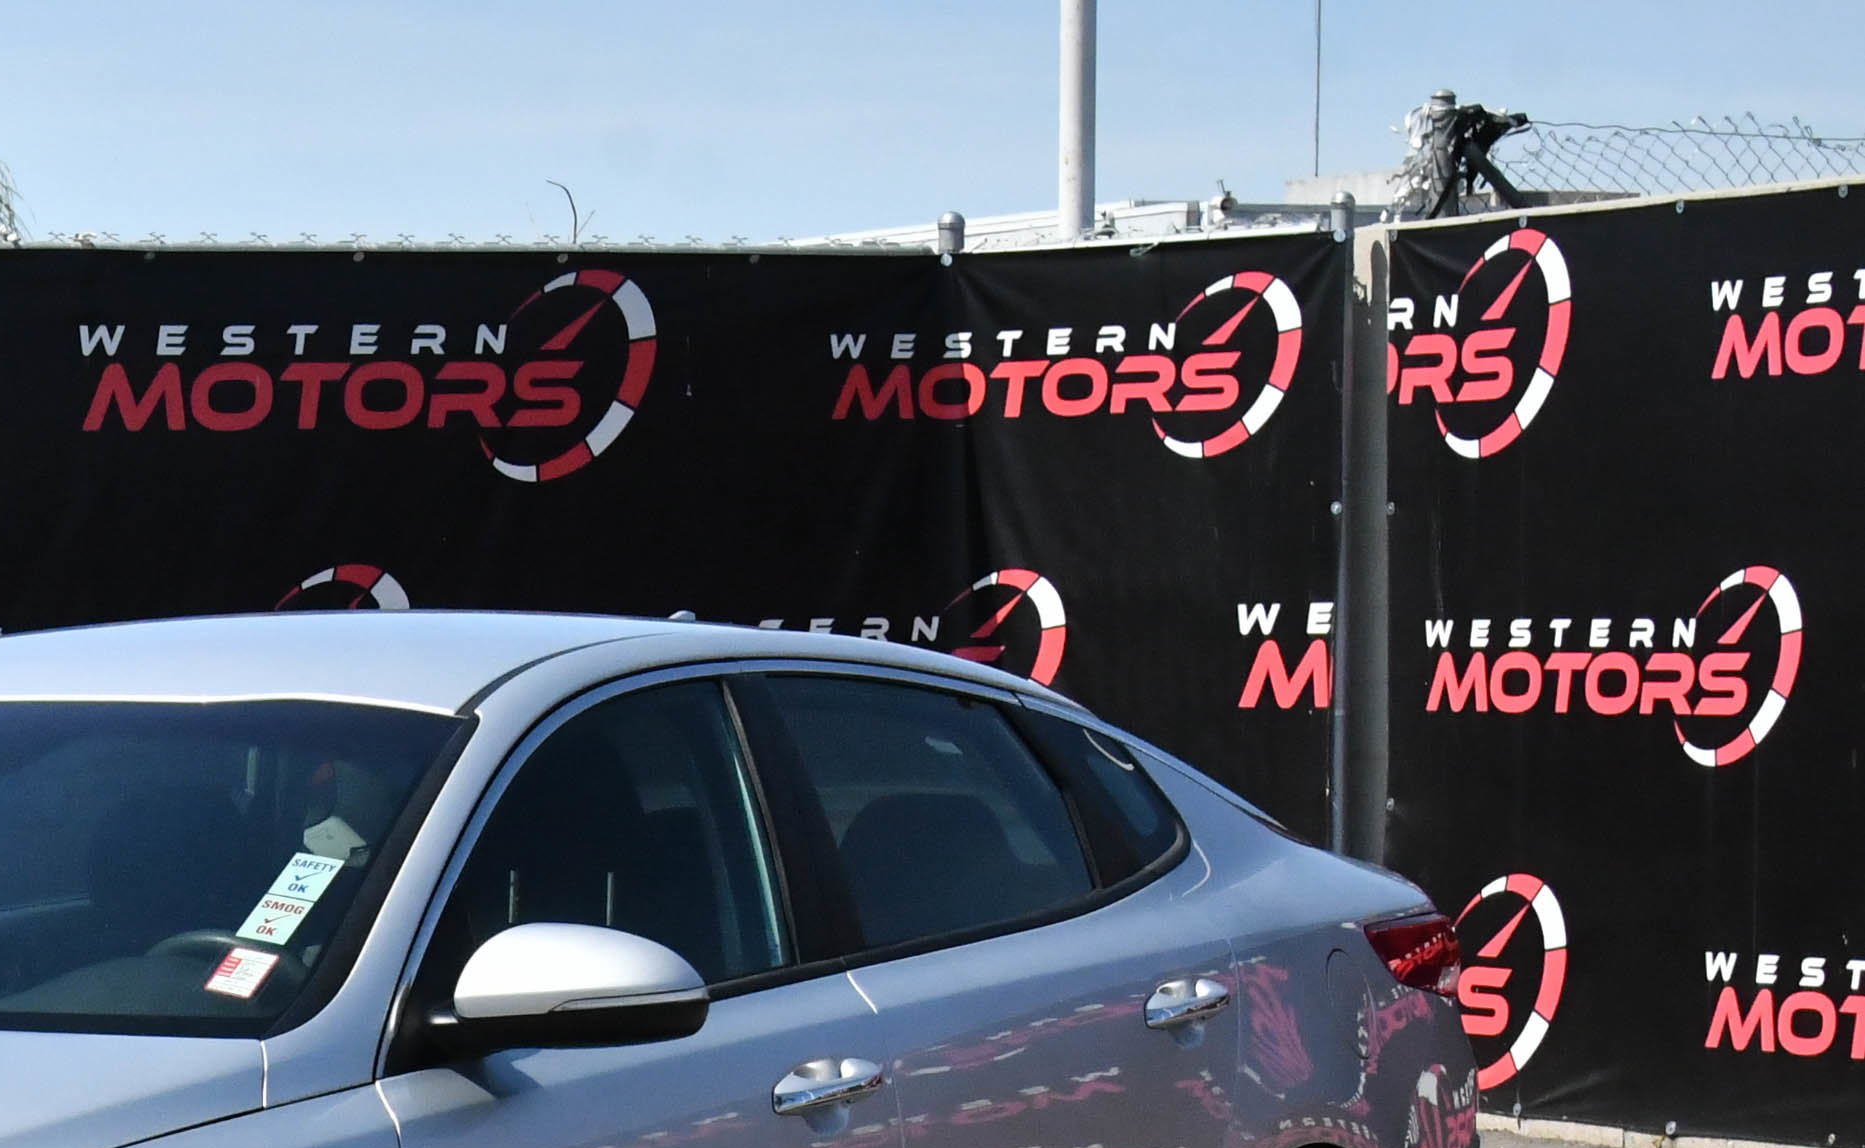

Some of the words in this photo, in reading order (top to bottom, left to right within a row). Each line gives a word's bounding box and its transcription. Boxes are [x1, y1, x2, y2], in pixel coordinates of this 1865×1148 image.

[80, 324, 507, 356] WESTERN
[831, 323, 1176, 360] WESTERN
[84, 361, 583, 431] MOTORS
[834, 350, 1242, 420] MOTORS
[1238, 602, 1334, 635] WE
[1425, 618, 1696, 648] WESTERN
[1426, 651, 1751, 715] MOTORS
[292, 858, 337, 873] SAFETY
[288, 882, 309, 894] OK
[261, 899, 306, 916] SMOG
[255, 924, 278, 936] OK
